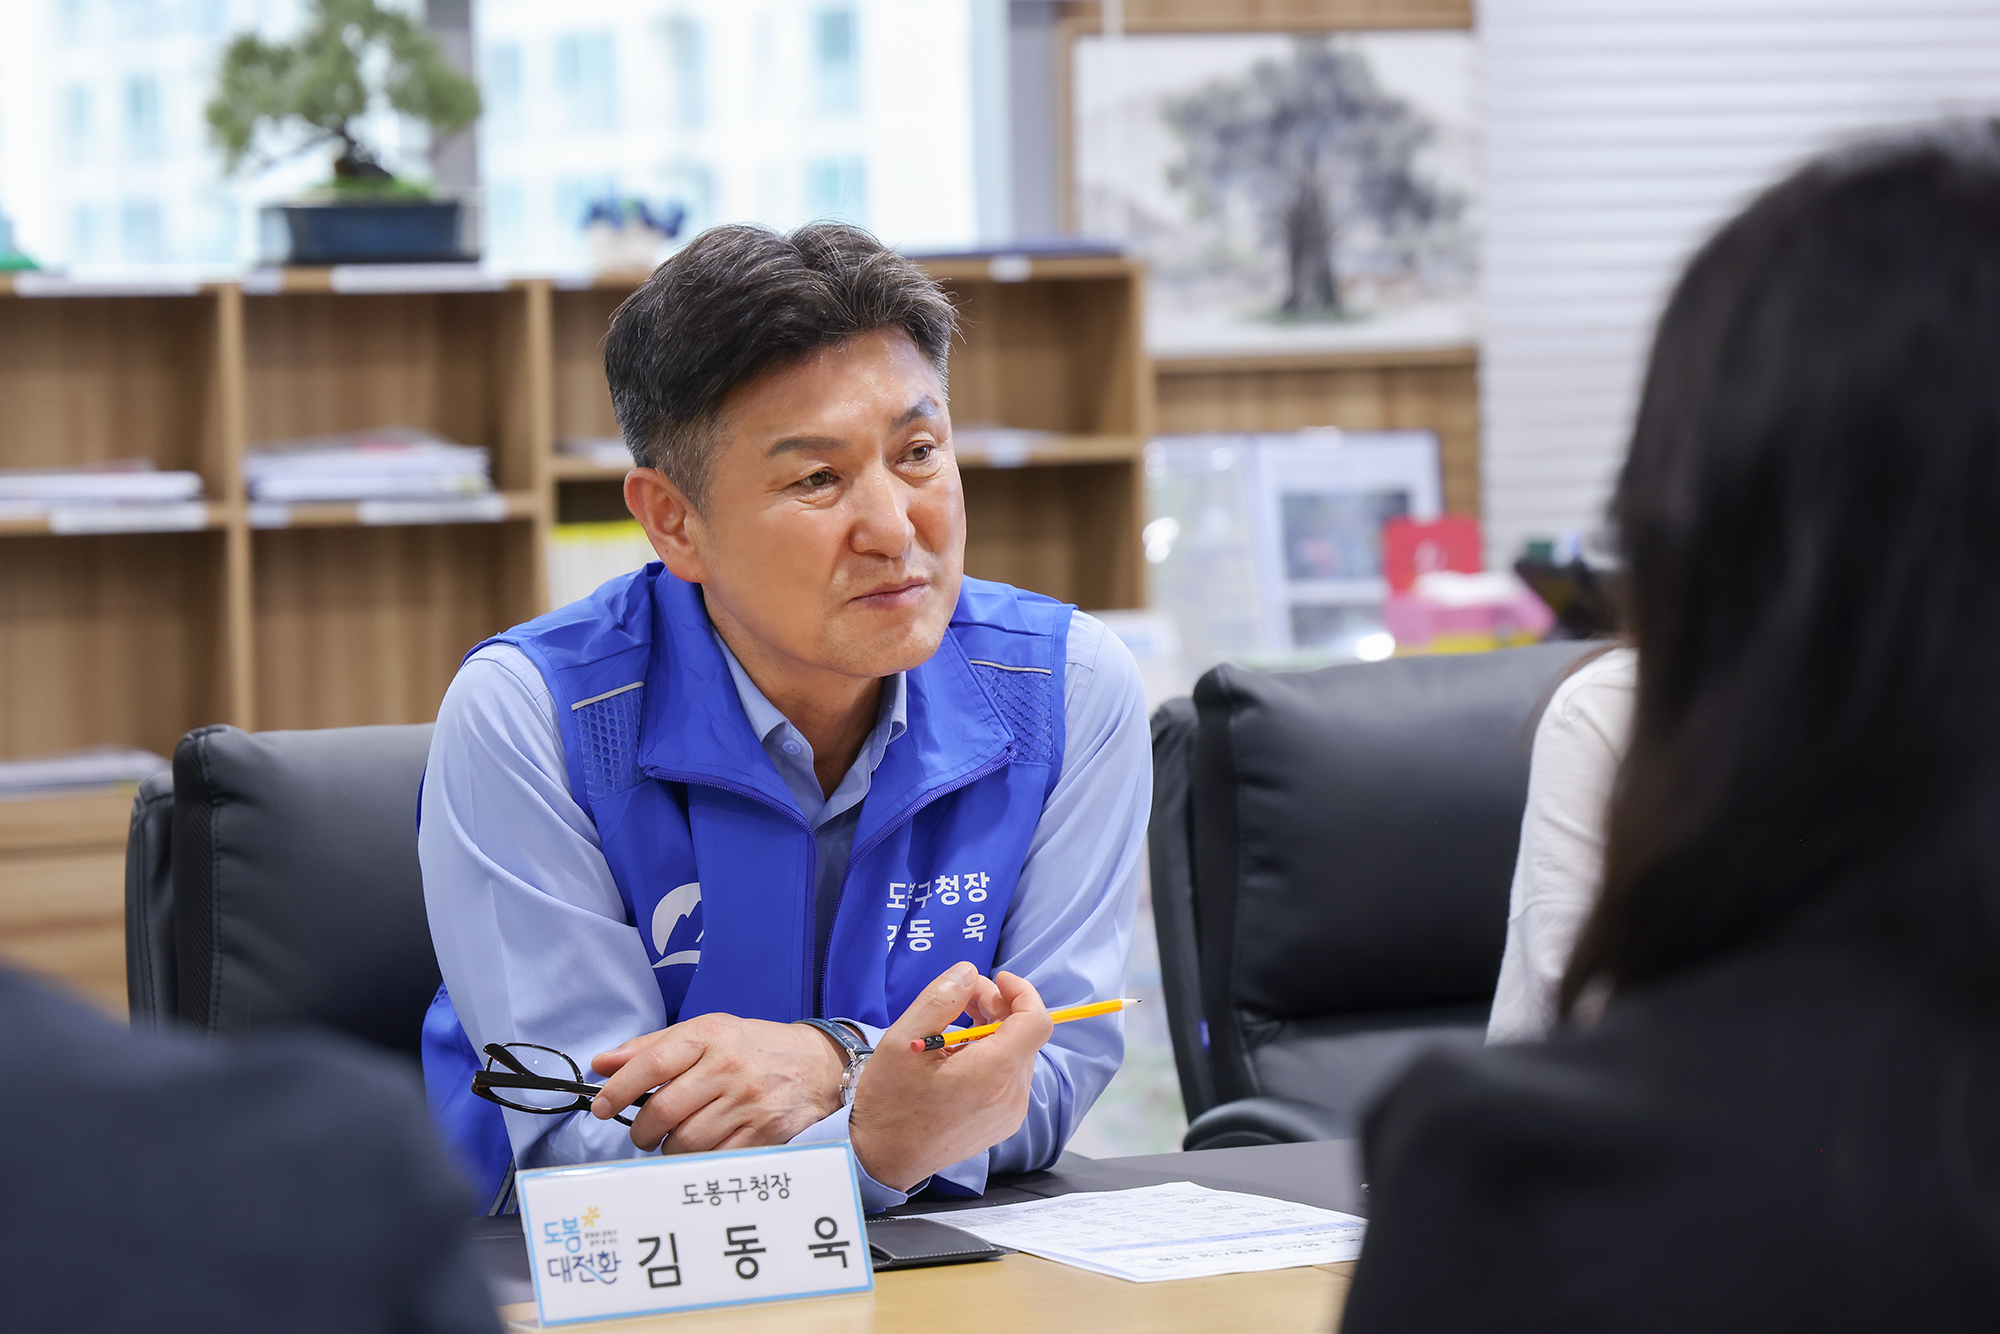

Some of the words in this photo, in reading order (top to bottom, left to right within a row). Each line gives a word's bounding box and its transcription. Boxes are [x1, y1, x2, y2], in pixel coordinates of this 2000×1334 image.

[682, 1172, 792, 1206] 도봉구청장
[544, 1216, 581, 1253] 도봉
[547, 1250, 621, 1285] 대전환
